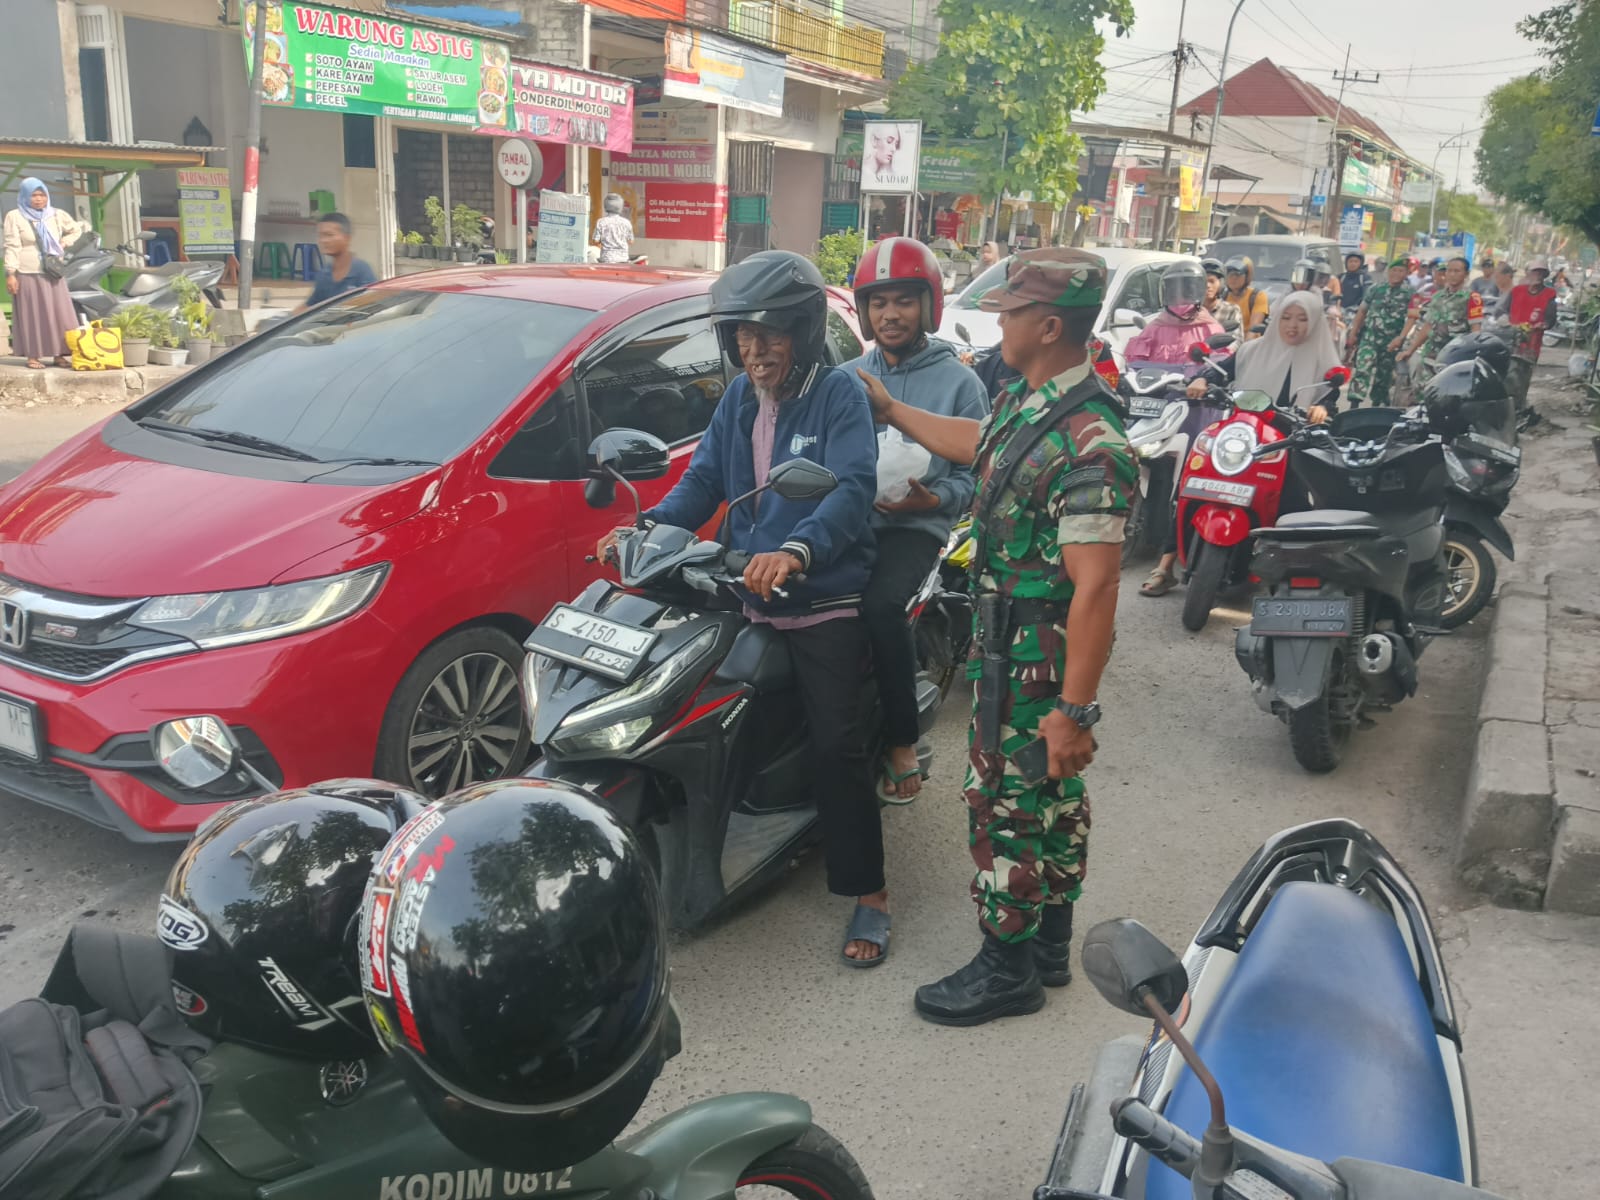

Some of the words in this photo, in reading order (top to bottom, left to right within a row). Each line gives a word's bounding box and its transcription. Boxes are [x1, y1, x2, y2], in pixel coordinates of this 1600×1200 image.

[295, 7, 405, 48] WARUNG
[411, 28, 474, 59] ASTIG
[316, 54, 343, 67] SOTO
[345, 59, 374, 72] AYAM
[349, 43, 380, 60] Sedia
[383, 49, 430, 67] Masakan
[316, 68, 342, 81] KARE
[344, 72, 374, 84] AYAM
[316, 81, 361, 95] PEPESAN
[415, 82, 444, 94] LODEH
[552, 72, 628, 106] MOTOR
[316, 94, 348, 106] PECEL
[416, 94, 448, 106] RAWON
[519, 91, 573, 112] ONDERDIL
[575, 101, 611, 119] MOTOR
[501, 152, 529, 167] TAMBAL
[610, 161, 672, 177] ONDERDIL
[673, 164, 714, 178] MOBIL
[45, 622, 78, 638] RS
[550, 613, 565, 628] S
[572, 620, 617, 644] 4150
[632, 637, 648, 652] J
[721, 697, 748, 729] HONDA
[159, 909, 194, 941] OG
[379, 1167, 494, 1200] KODIM
